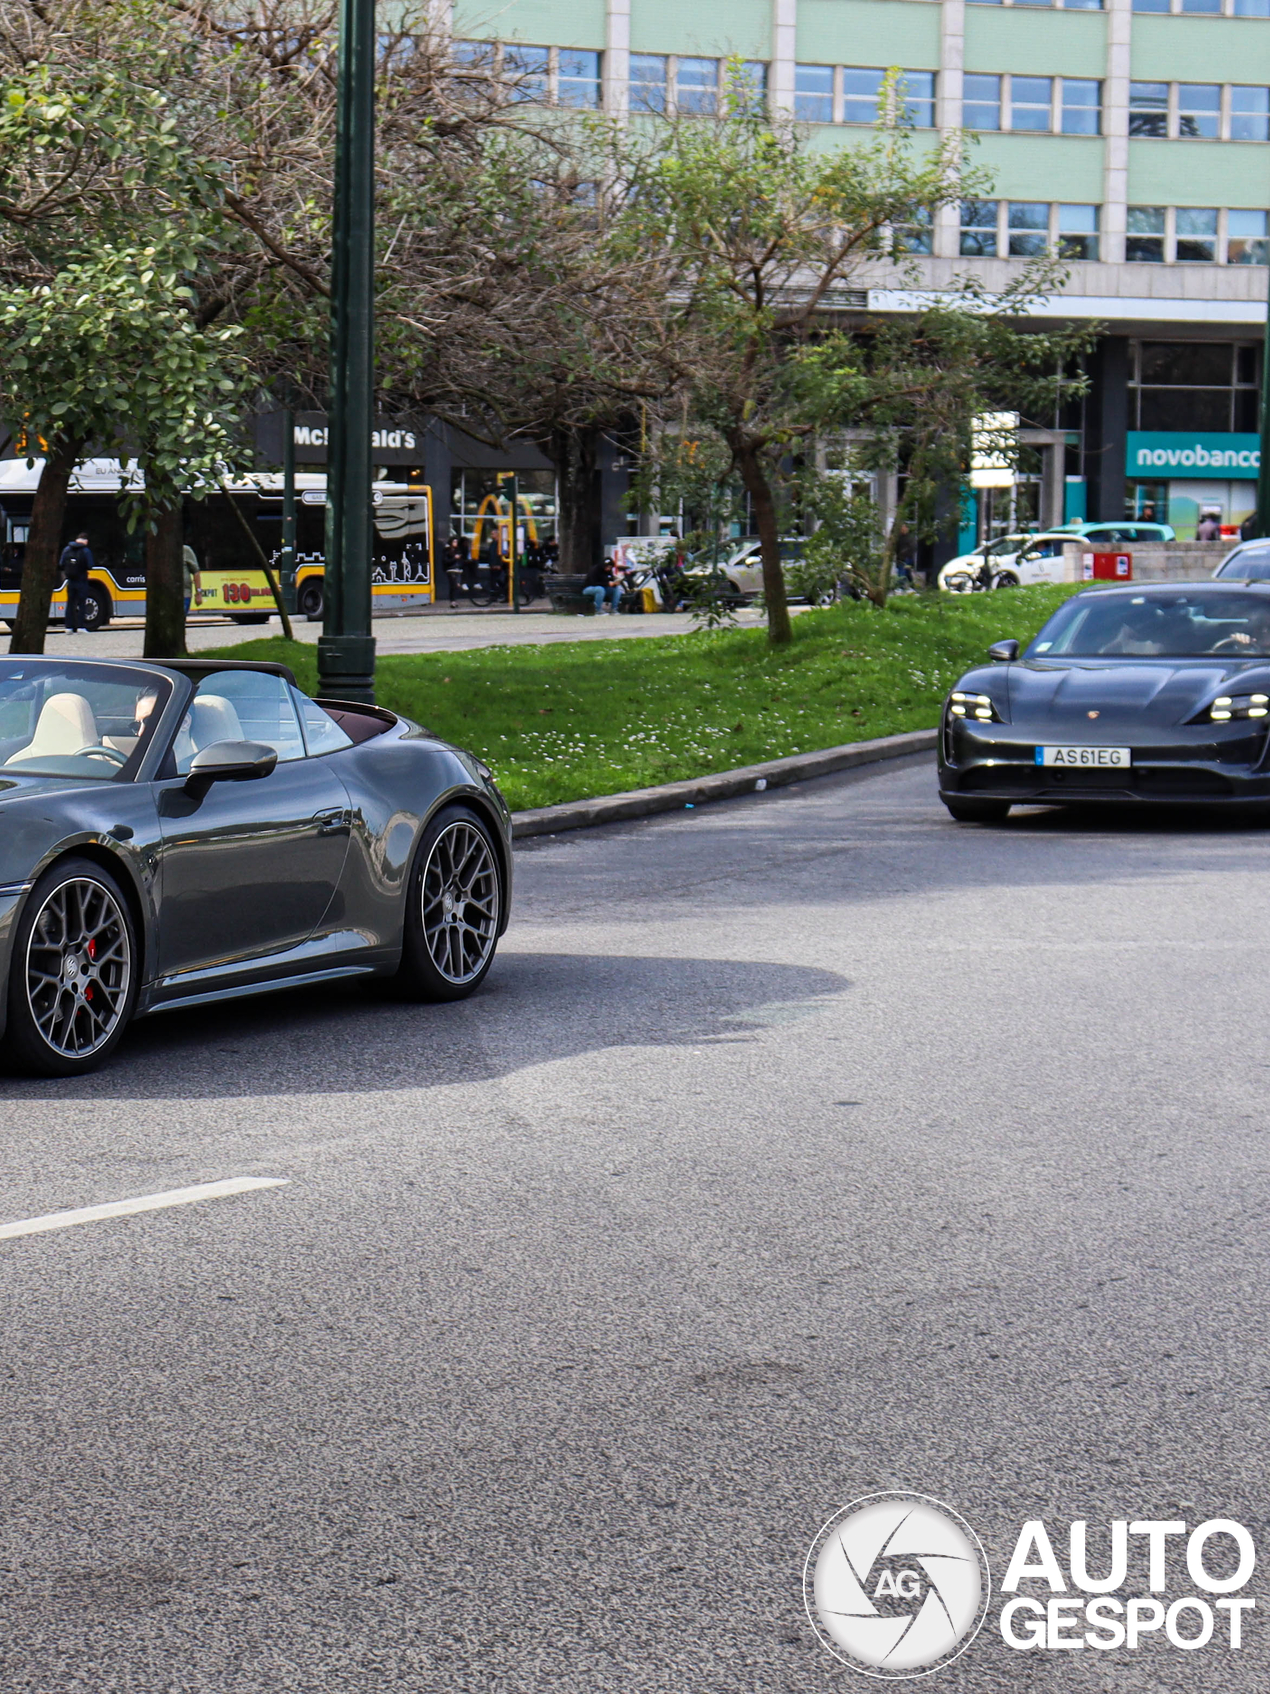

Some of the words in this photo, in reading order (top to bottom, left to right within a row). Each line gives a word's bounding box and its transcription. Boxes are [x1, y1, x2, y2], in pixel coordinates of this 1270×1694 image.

[294, 426, 416, 449] Mcald's
[126, 574, 146, 583] carris
[223, 583, 250, 603] 130
[1054, 749, 1121, 765] AS61EG
